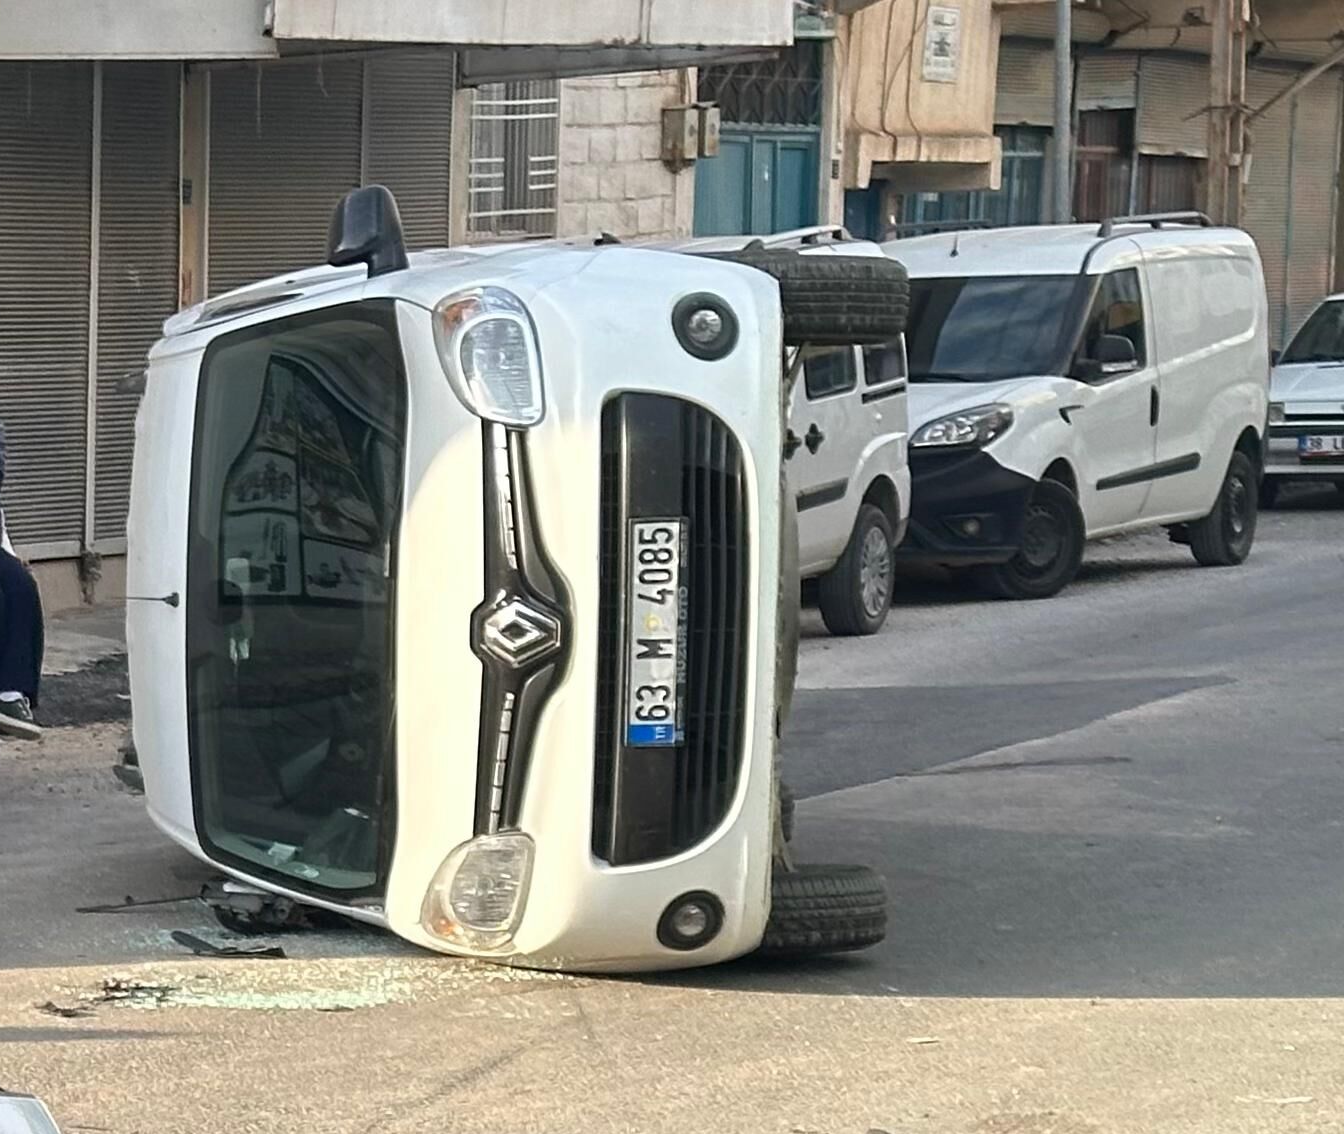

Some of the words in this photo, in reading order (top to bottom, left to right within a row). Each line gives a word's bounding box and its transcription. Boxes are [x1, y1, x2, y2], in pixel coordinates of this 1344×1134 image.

[1332, 437, 1344, 450] L
[637, 527, 674, 606] 4085
[678, 586, 688, 621] OTO
[636, 638, 673, 660] M
[635, 684, 671, 722] 63
[655, 726, 667, 739] TR
